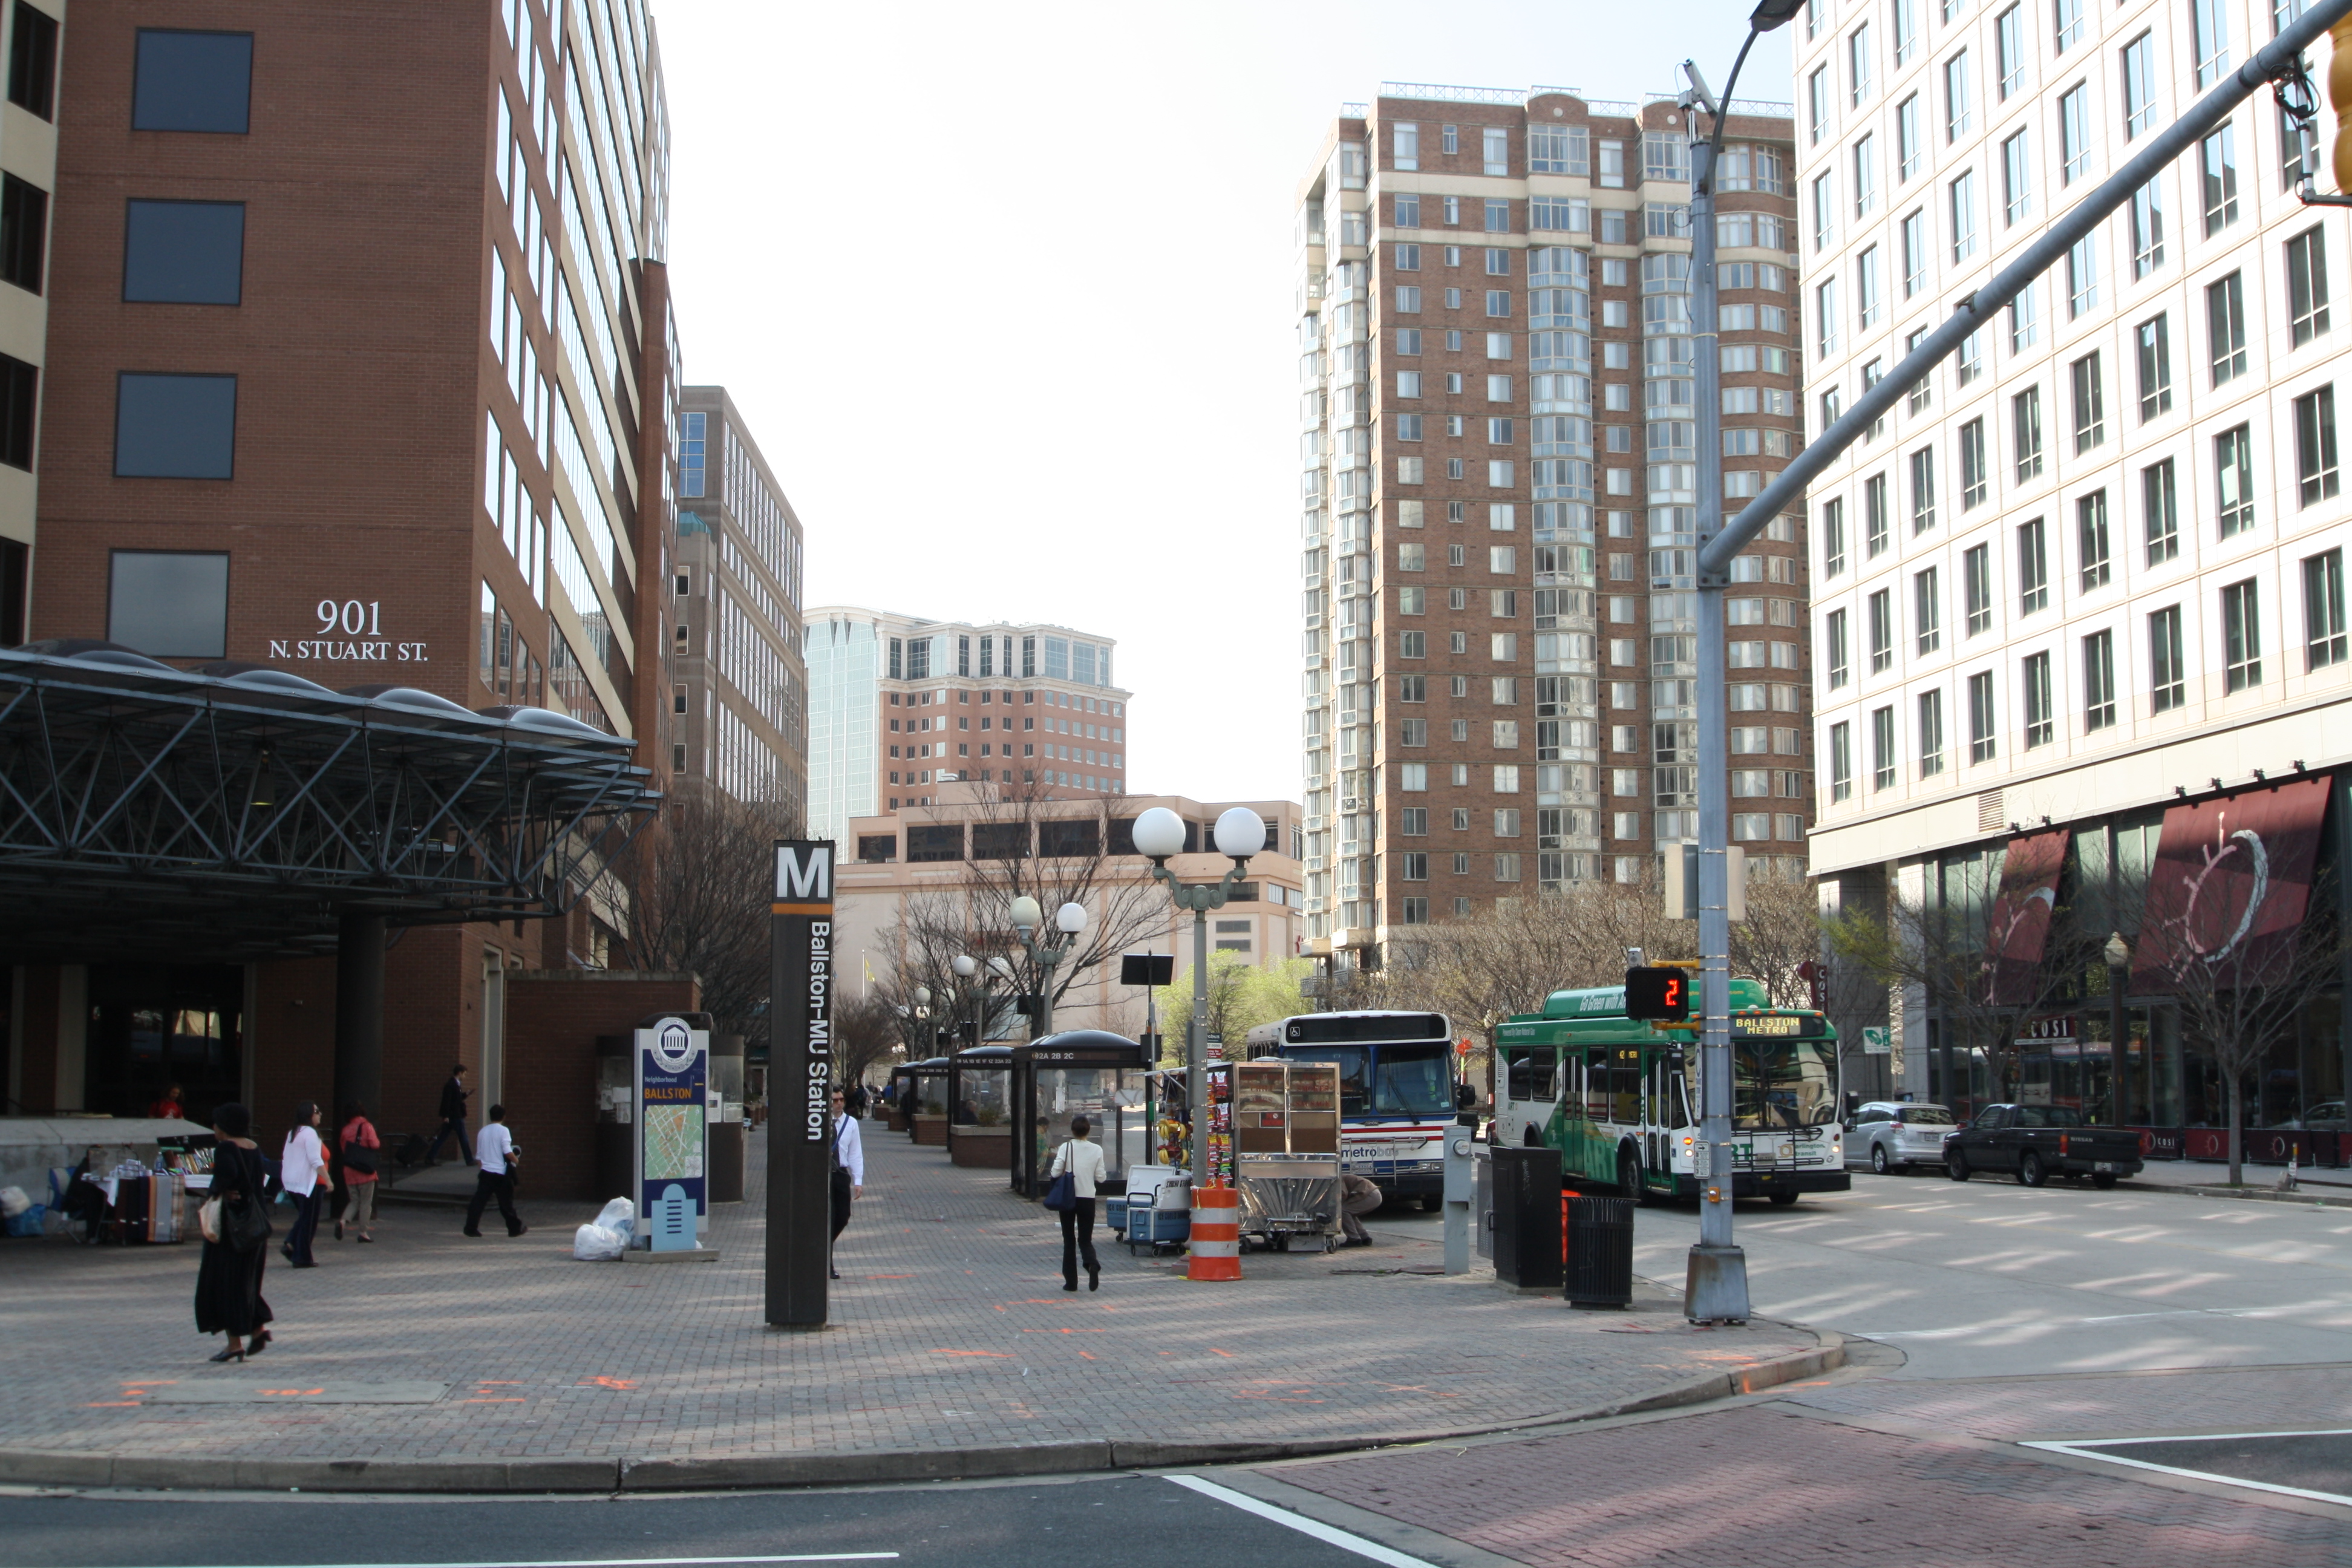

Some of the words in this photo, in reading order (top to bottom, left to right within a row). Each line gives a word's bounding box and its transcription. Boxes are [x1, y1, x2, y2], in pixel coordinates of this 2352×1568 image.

[317, 599, 381, 635] 901
[269, 640, 291, 658] N.
[297, 641, 391, 660] STUART
[397, 642, 428, 661] ST.
[777, 847, 829, 898] M
[809, 921, 829, 1054] Ballston-MU
[1665, 979, 1679, 1006] 2
[1587, 995, 1606, 1011] Green
[1736, 1017, 1800, 1027] BALLSTON
[1746, 1026, 1788, 1034] METRO
[644, 1088, 691, 1099] BALLSTON
[808, 1062, 828, 1140] Station
[1342, 1146, 1399, 1158] metrobus
[1731, 1143, 1753, 1160] RT
